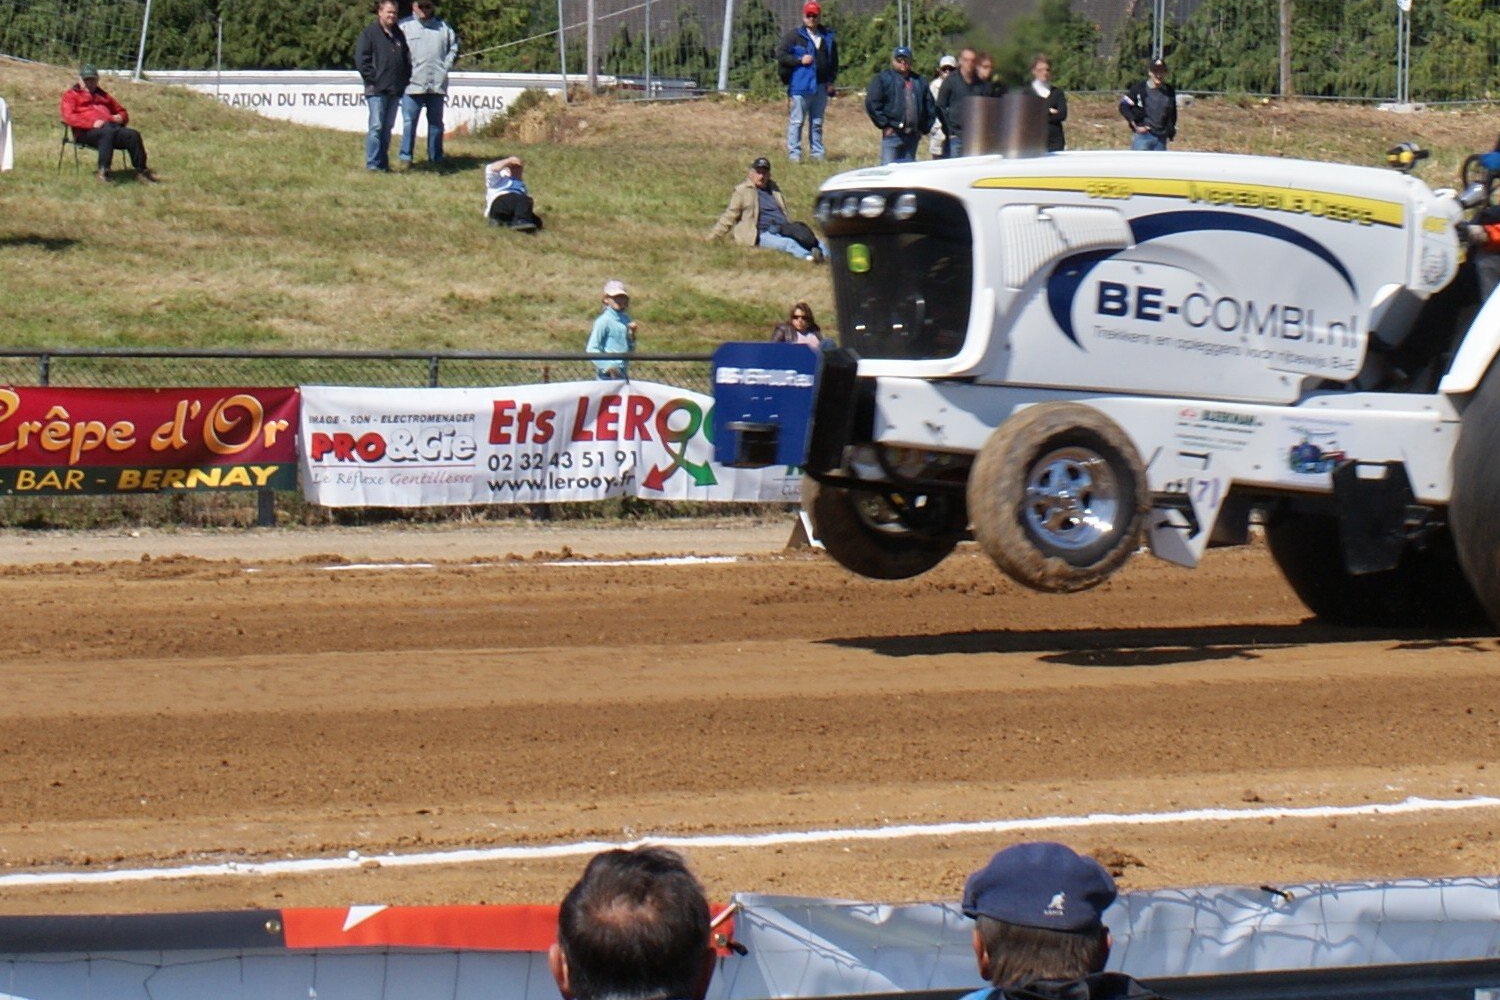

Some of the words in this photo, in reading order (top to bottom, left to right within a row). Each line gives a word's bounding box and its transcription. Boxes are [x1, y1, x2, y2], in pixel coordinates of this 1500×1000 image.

[277, 93, 296, 107] DU
[302, 93, 367, 107] TRACTEUR
[443, 94, 504, 110] RANÇAIS
[1096, 280, 1359, 348] BE-COMBI.nl
[150, 394, 290, 455] d'Or
[308, 414, 340, 425] IMAGE
[350, 415, 371, 425] SON
[381, 413, 477, 424] ELECTROMENAGER
[488, 399, 557, 445] Ets
[571, 393, 715, 445] LERO
[310, 425, 478, 462] PRO&Cie
[488, 453, 513, 471] 02
[519, 452, 544, 471] 32
[549, 451, 573, 469] 43
[582, 450, 605, 468] 51
[614, 450, 638, 467] 91
[16, 469, 86, 490] BAR
[117, 466, 280, 490] BERNAY
[312, 471, 330, 485] Le
[390, 470, 474, 486] Gentillesse
[487, 471, 637, 493] www.lerooy.fr
